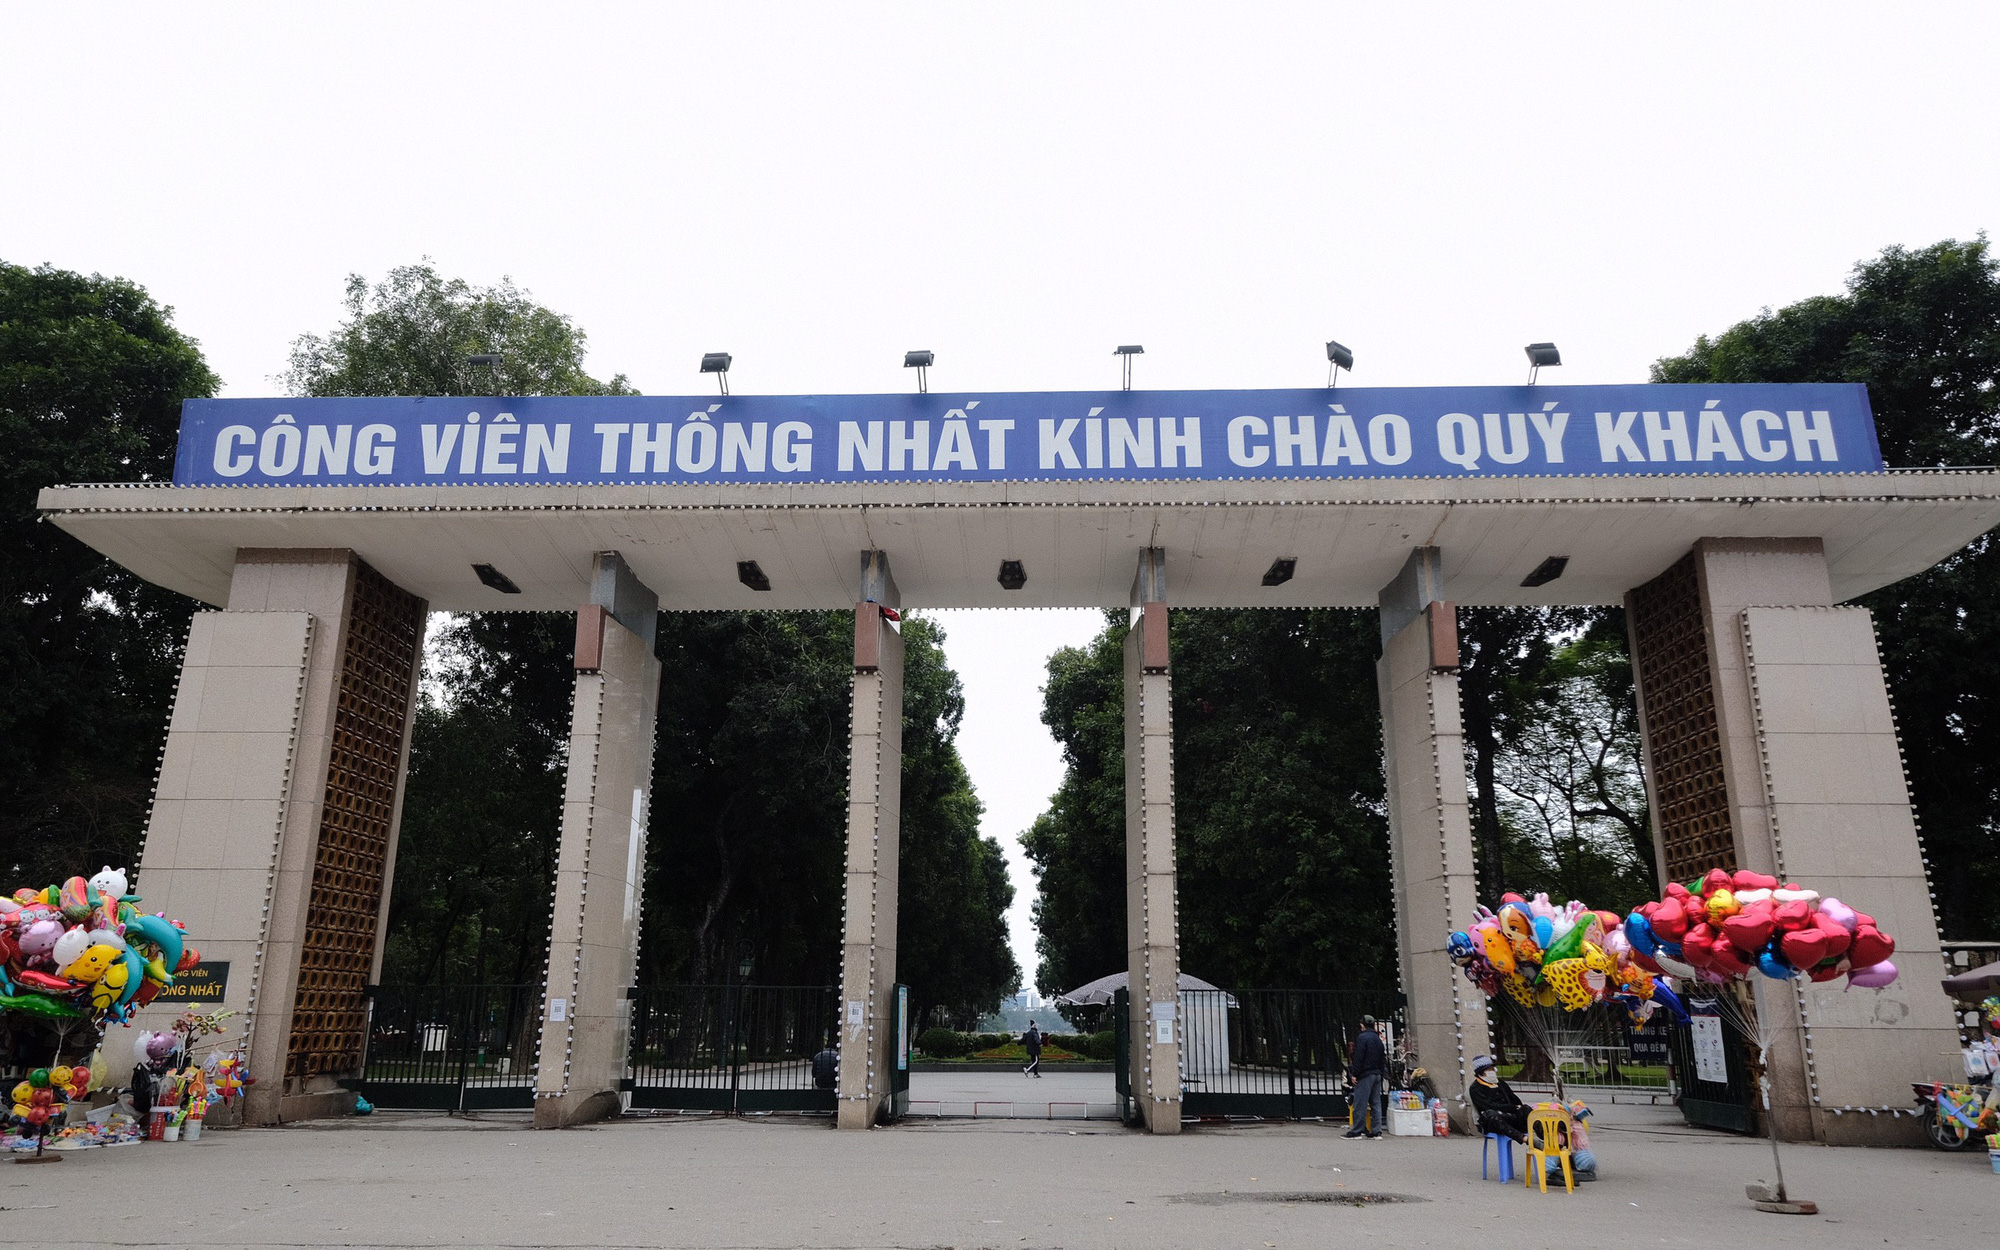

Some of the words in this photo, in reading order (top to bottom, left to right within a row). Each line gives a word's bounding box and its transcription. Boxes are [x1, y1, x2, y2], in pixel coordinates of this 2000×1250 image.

[213, 413, 397, 477] CÔNG
[593, 403, 813, 474] THỐNG
[837, 401, 1016, 472] NHẤT
[1038, 406, 1202, 469] KÍNH
[1227, 403, 1413, 467] CHÀO
[1436, 401, 1570, 471] QUÝ
[1594, 400, 1839, 463] KHÁCH
[190, 968, 209, 978] VIÊN
[189, 980, 223, 996] NHẤT
[1633, 1043, 1649, 1053] QUA
